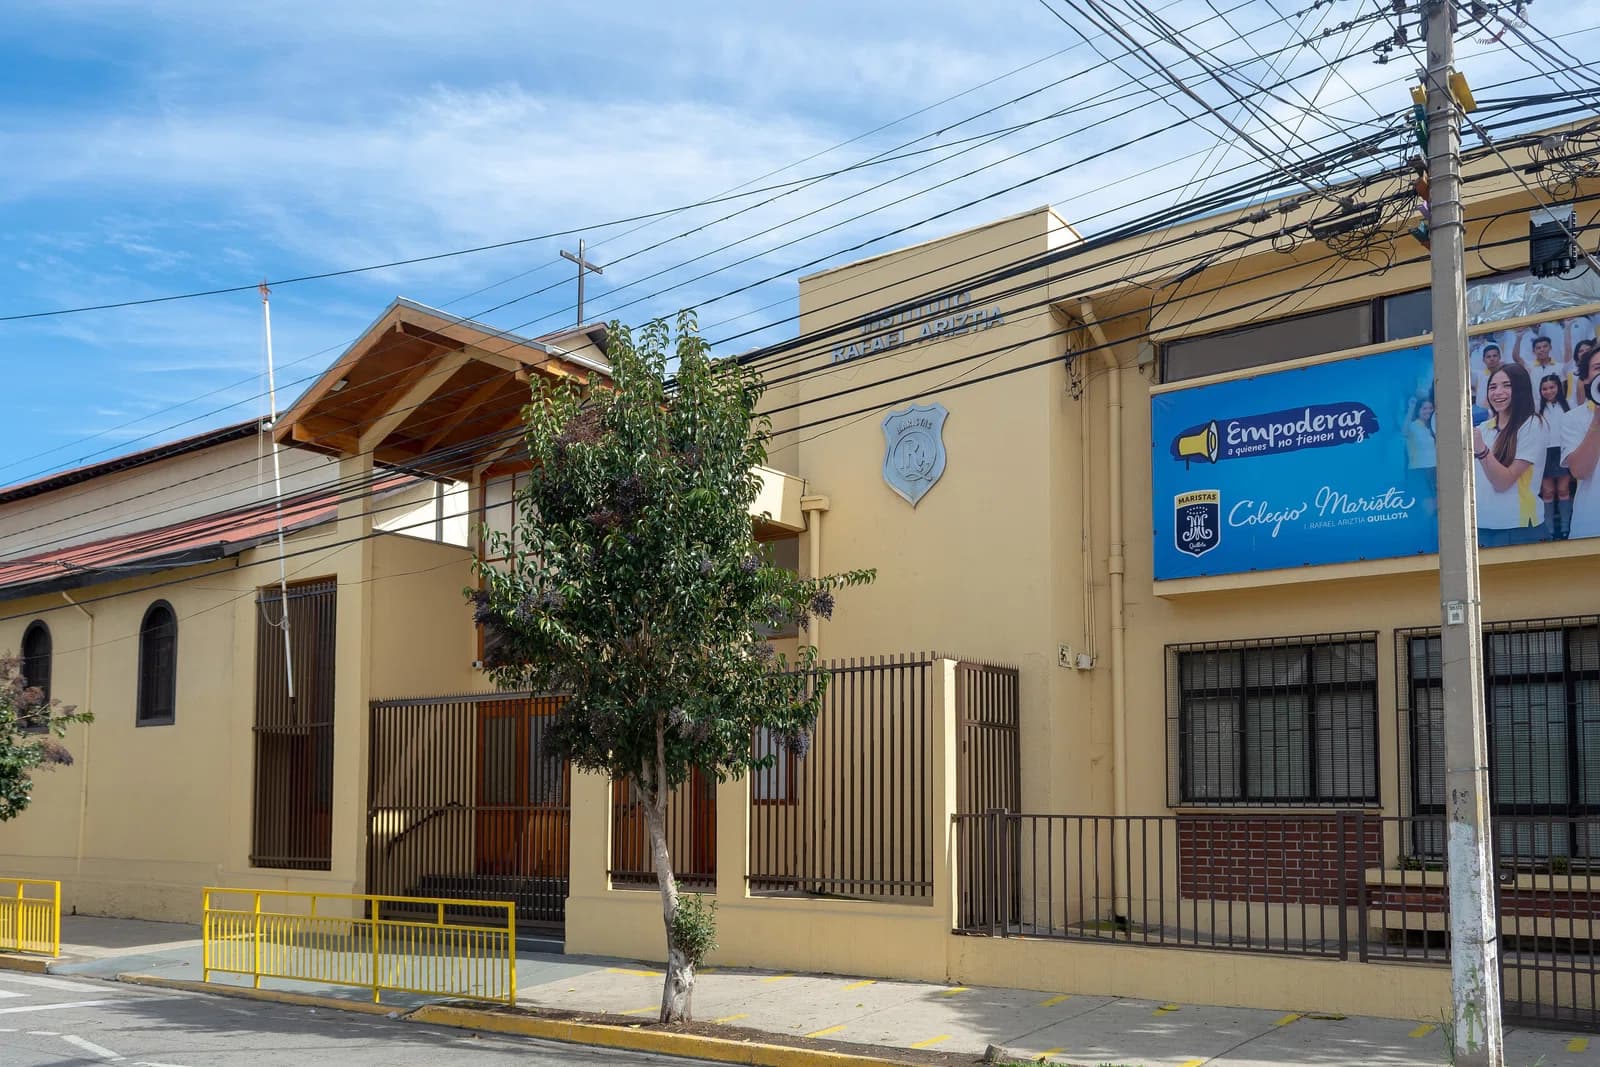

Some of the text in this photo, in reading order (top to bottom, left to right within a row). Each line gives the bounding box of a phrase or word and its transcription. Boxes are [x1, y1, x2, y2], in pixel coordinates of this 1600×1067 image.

[1226, 407, 1367, 448] Empoderar
[1235, 443, 1267, 456] quienes
[1277, 438, 1293, 448] no
[1295, 432, 1335, 446] tienen
[1339, 425, 1367, 444] voz
[1178, 493, 1217, 504] MARISTAS
[1228, 486, 1416, 538] Colegio Marista
[1309, 521, 1336, 530] RAFAEL
[1337, 517, 1366, 527] ARIZTIA
[1367, 511, 1409, 524] QUILLOTA
